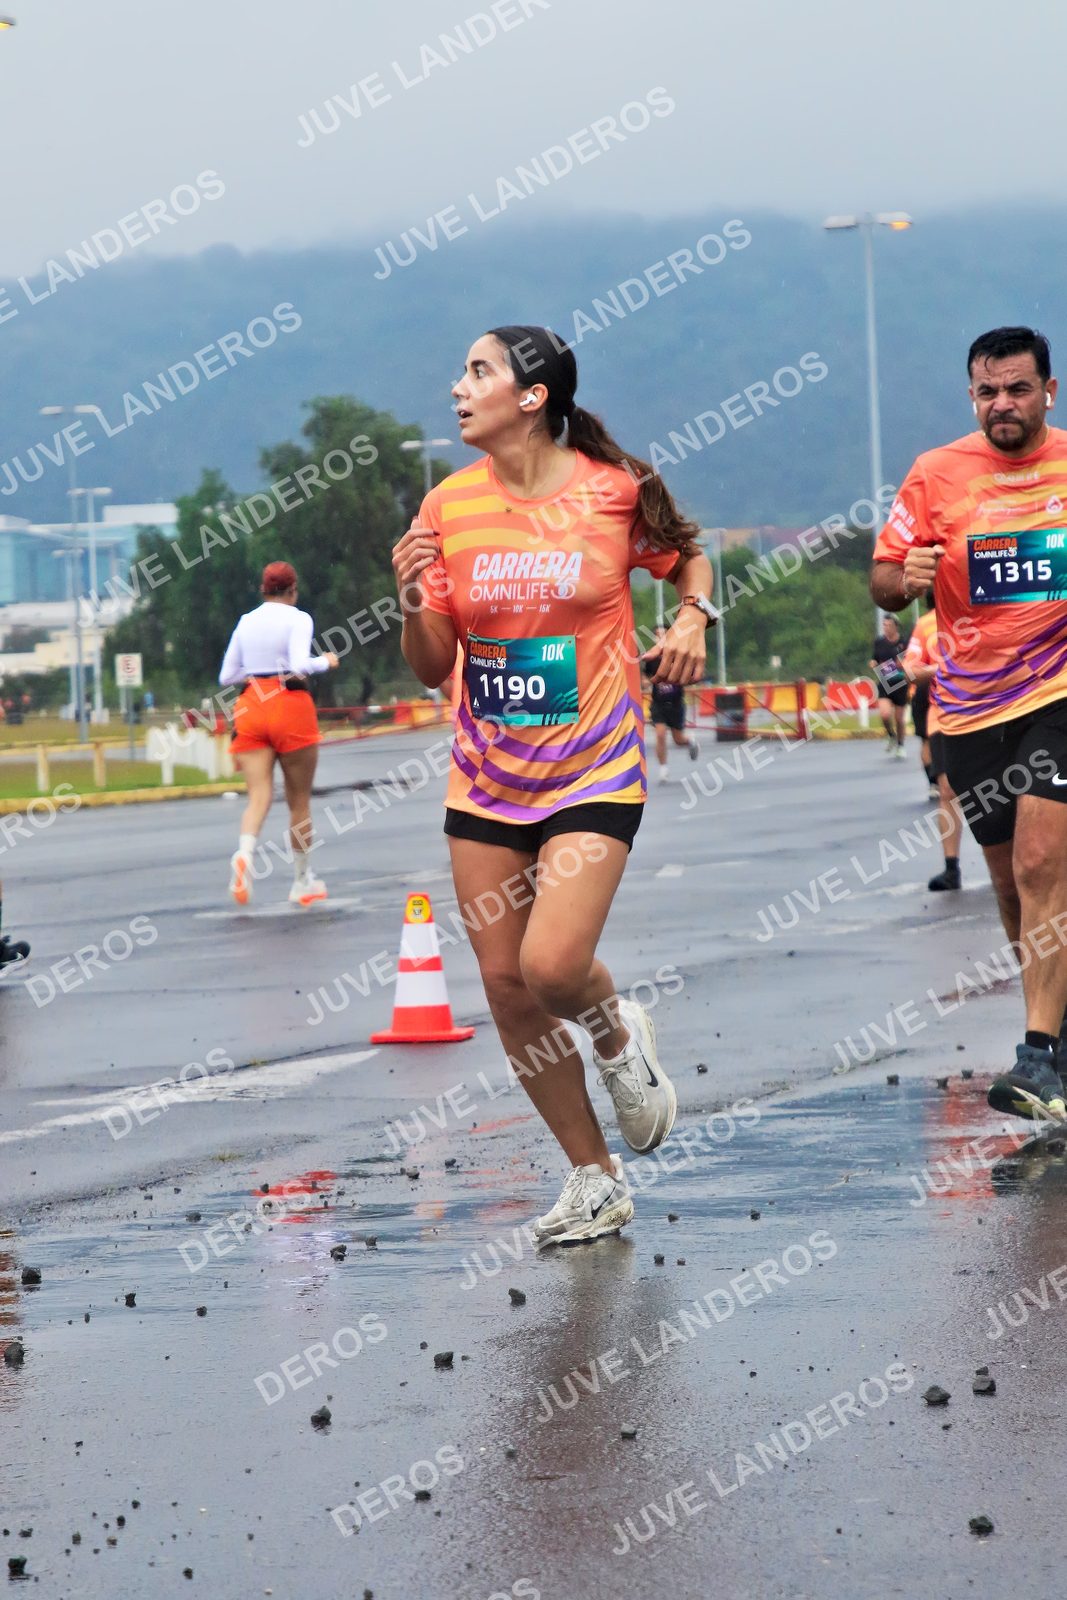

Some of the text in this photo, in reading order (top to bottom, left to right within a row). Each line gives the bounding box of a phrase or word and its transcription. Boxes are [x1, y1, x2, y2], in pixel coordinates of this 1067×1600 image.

[974, 533, 1064, 551] CARRERA 10K
[472, 552, 583, 581] CARRERA
[990, 560, 1052, 583] 1315
[470, 641, 565, 661] CARRERA 10K
[480, 673, 546, 700] 1190
